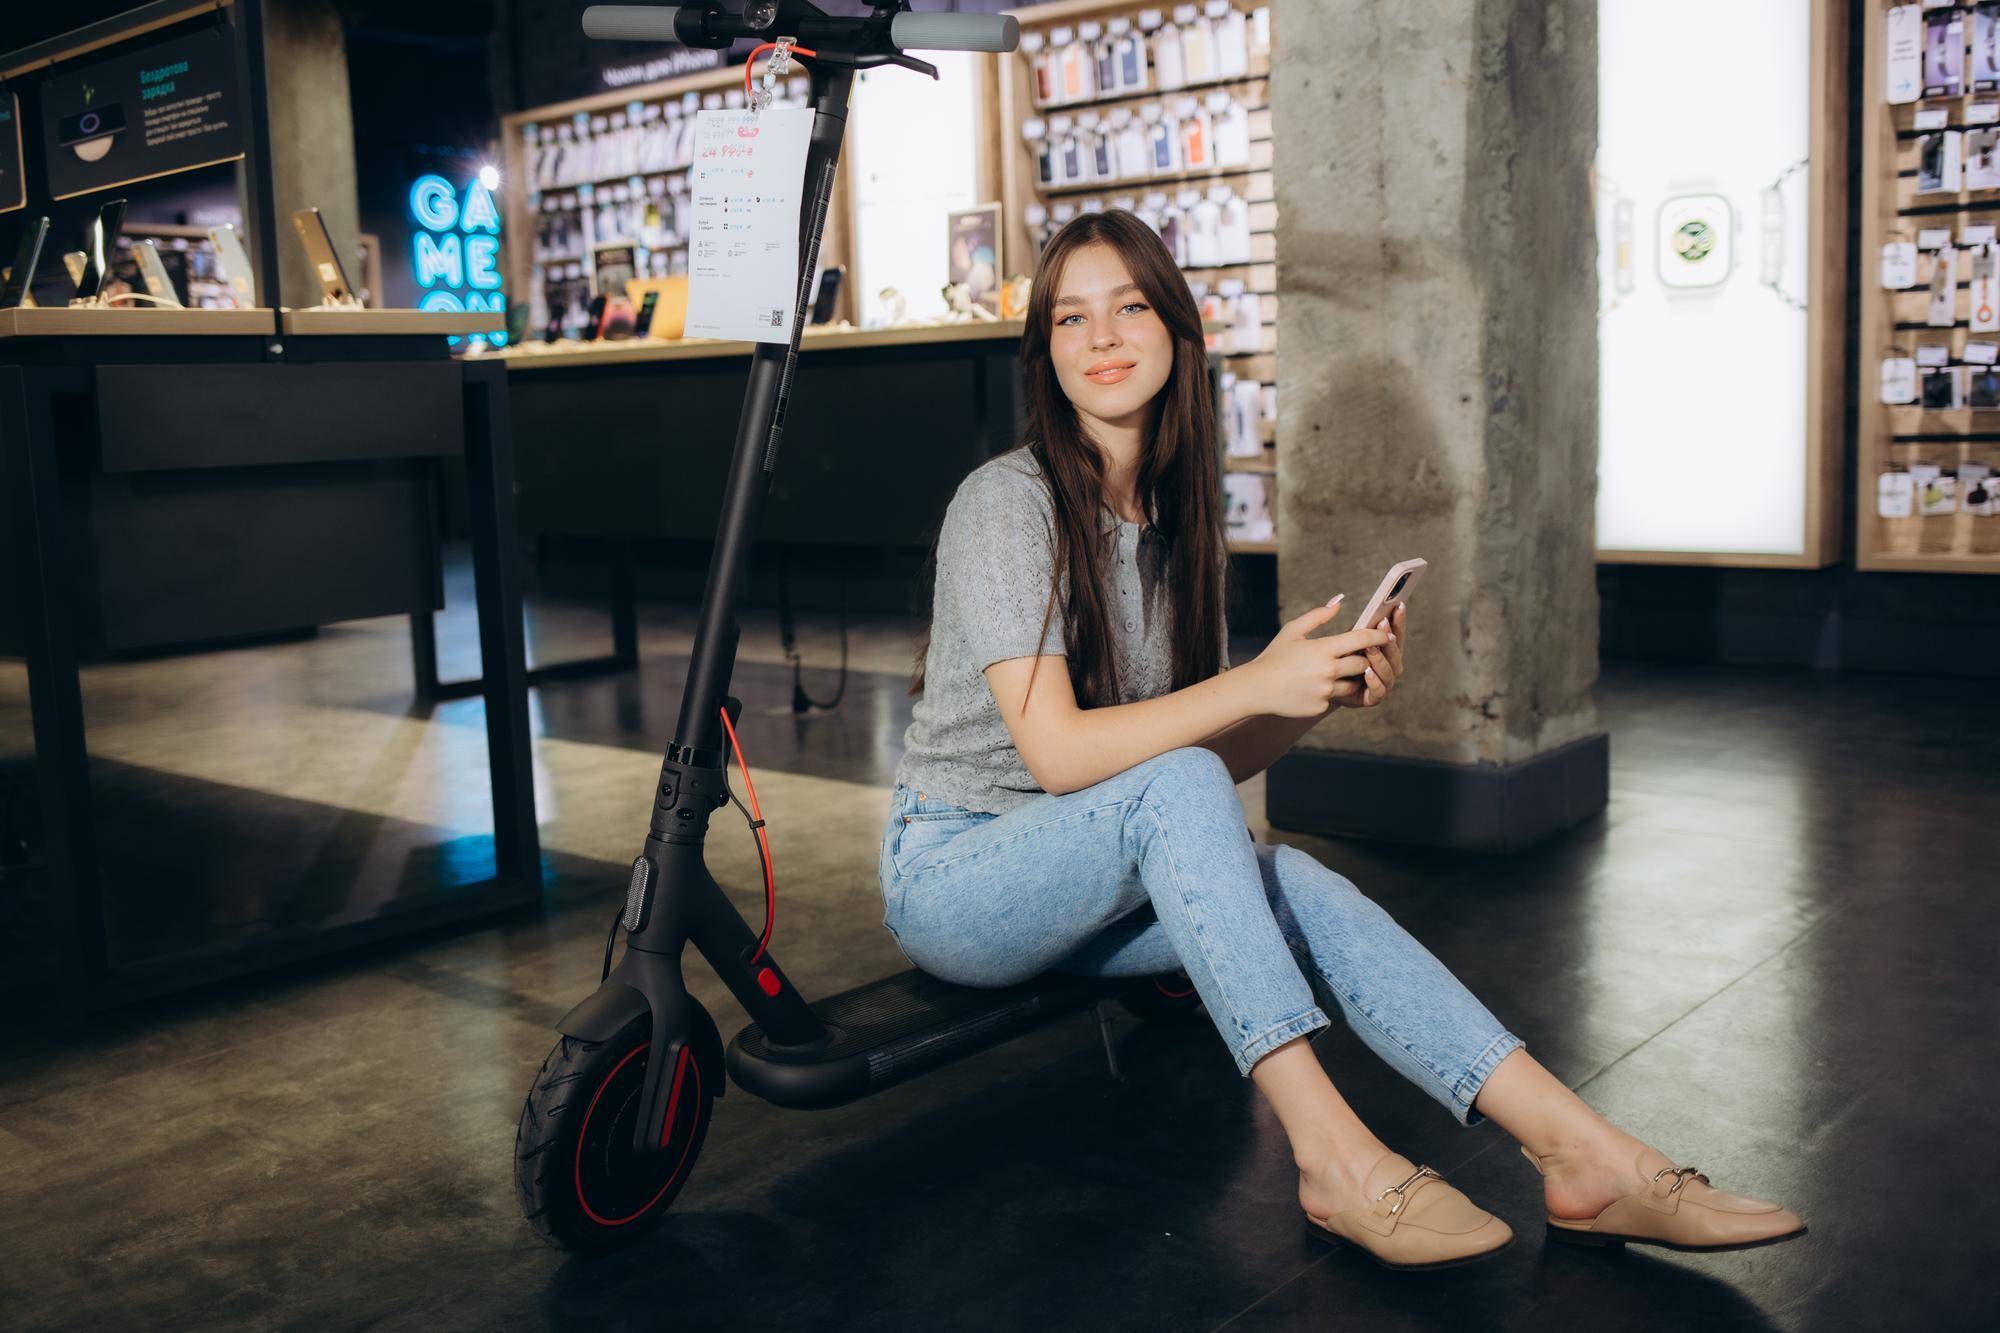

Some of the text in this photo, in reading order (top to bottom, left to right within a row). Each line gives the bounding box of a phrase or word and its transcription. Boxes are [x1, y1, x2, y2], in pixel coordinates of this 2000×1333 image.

[140, 60, 189, 85] Бездротова
[142, 81, 176, 101] зарядка
[409, 174, 500, 235] GA
[412, 230, 503, 290] ME
